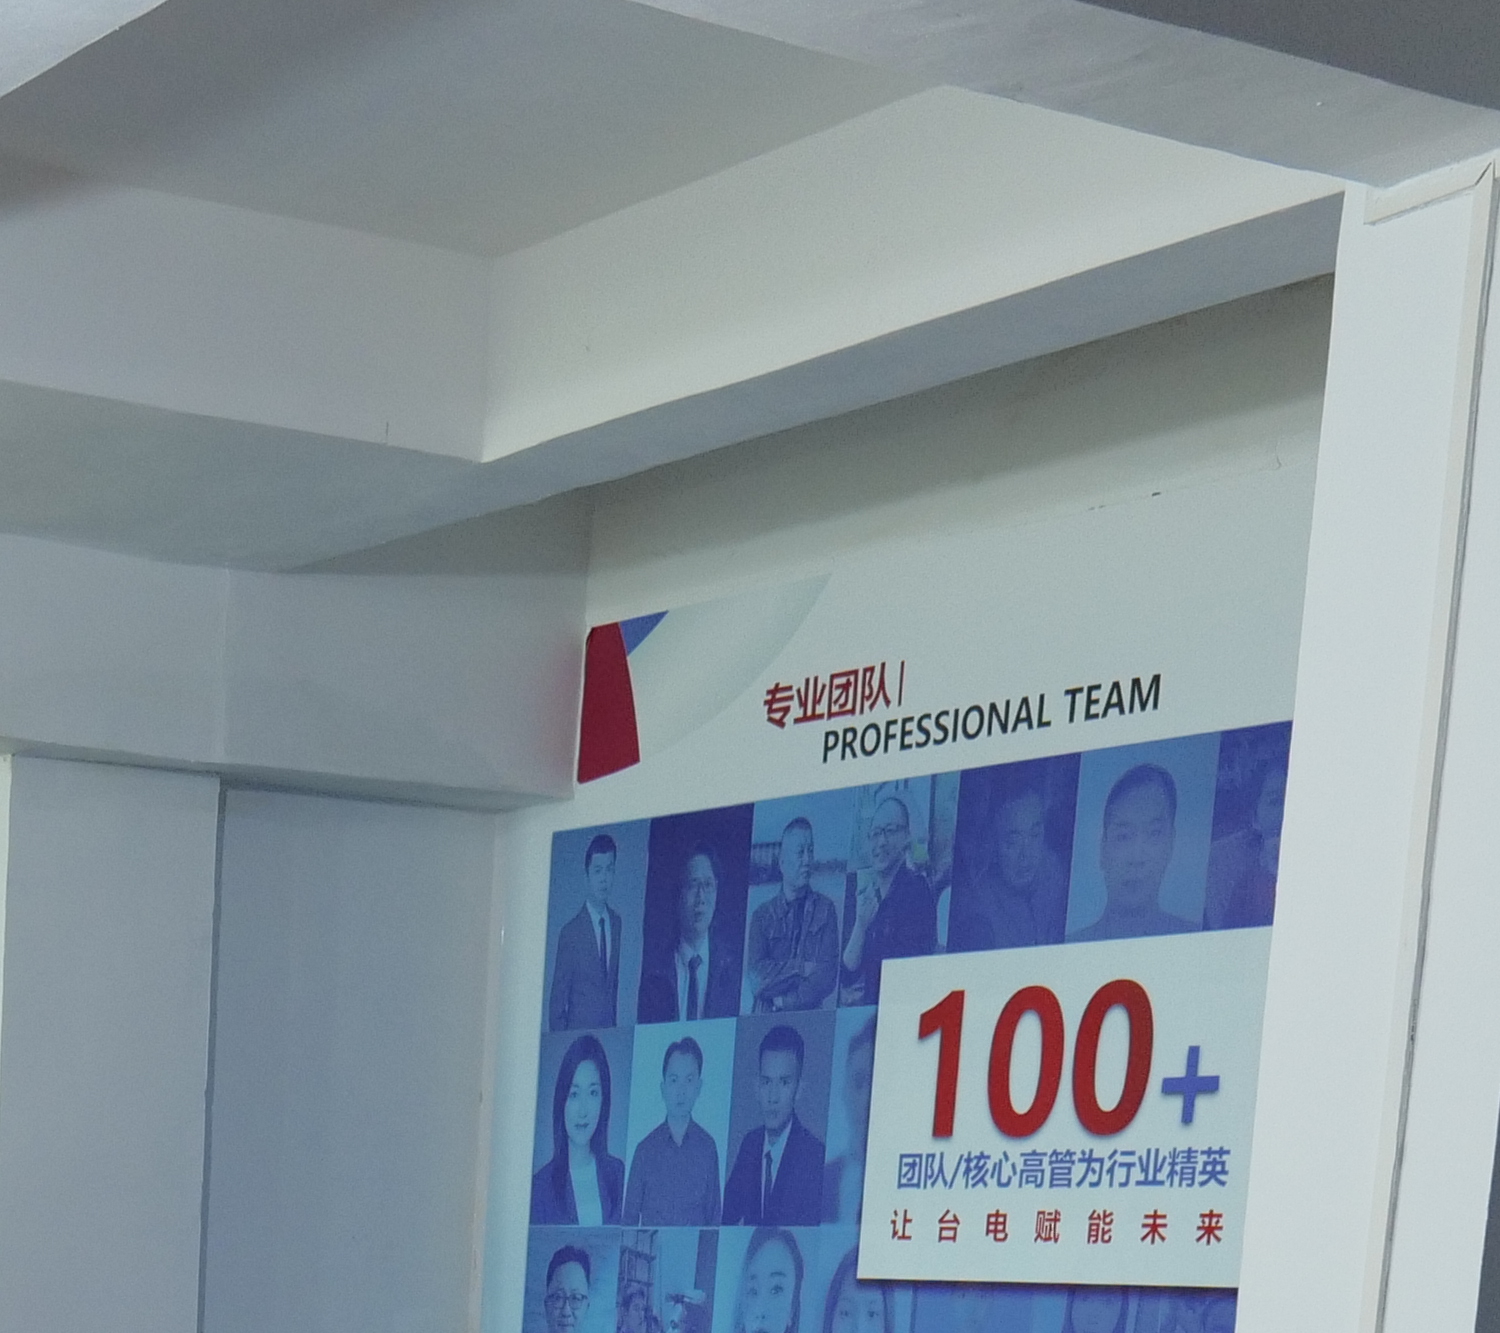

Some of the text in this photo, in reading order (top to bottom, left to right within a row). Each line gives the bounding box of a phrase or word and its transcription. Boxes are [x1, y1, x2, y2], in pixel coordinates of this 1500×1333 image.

[762, 666, 892, 730] 专业团队
[822, 673, 1163, 764] PROFESSIONAL TEAM
[917, 978, 1221, 1138] 100+
[896, 1146, 1231, 1190] 团队/核心高管为行业精英
[889, 1208, 1225, 1245] 让台电赋能未来
